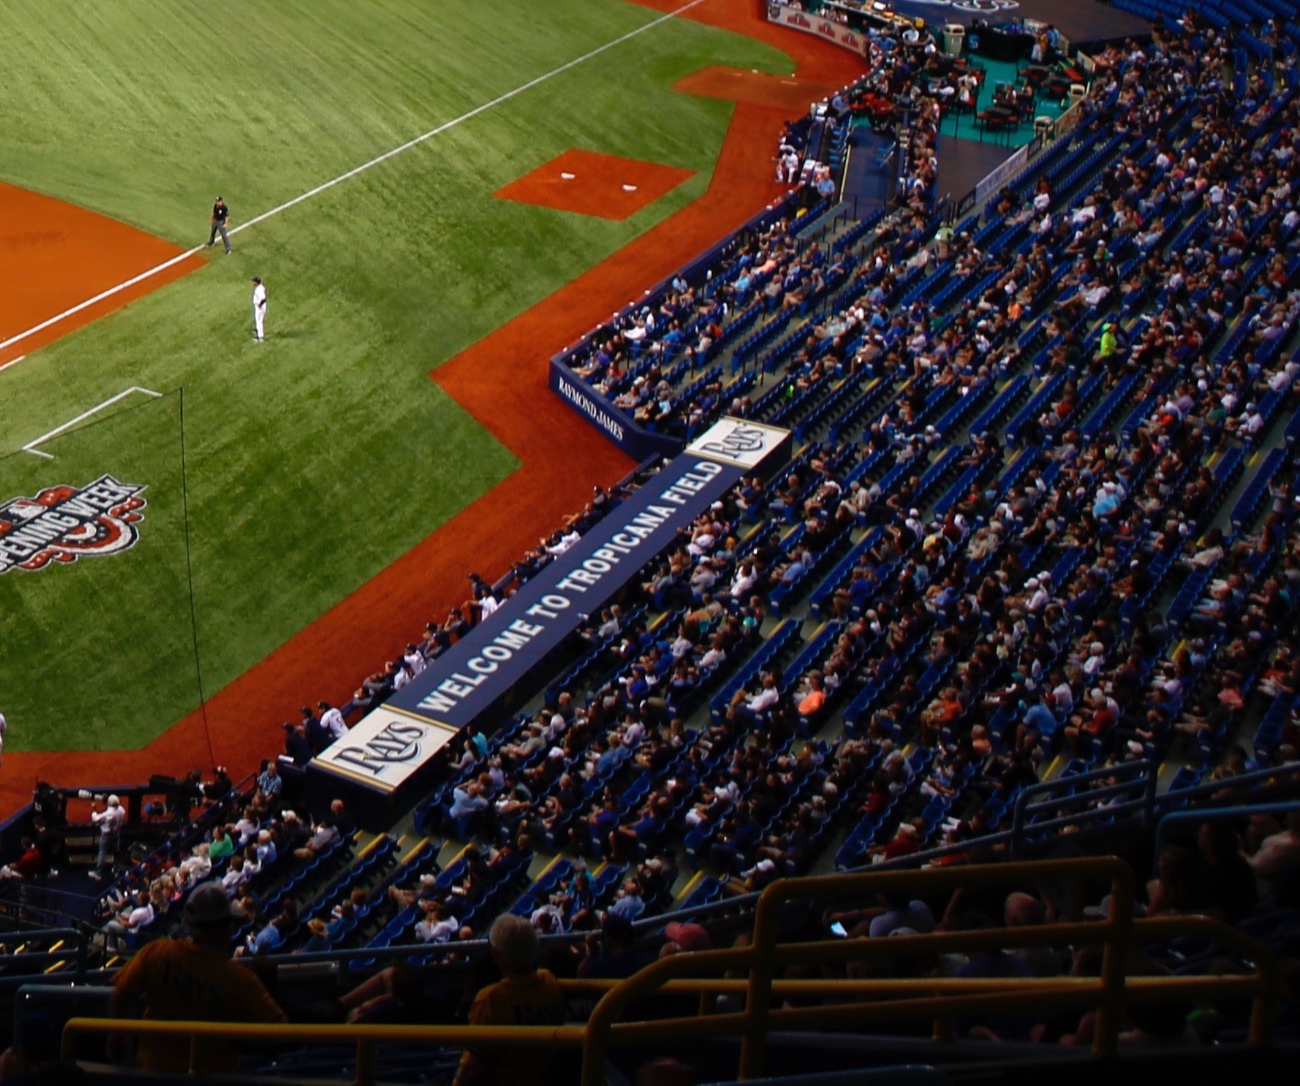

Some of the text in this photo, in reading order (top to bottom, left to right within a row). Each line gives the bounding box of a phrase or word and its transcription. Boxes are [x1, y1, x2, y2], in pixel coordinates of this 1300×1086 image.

[558, 376, 625, 442] RAYMOND JAMES
[56, 478, 138, 517] WEEK
[417, 460, 723, 713] WELCOME TO TROPICANA FIELD
[334, 720, 427, 775] RAYS
